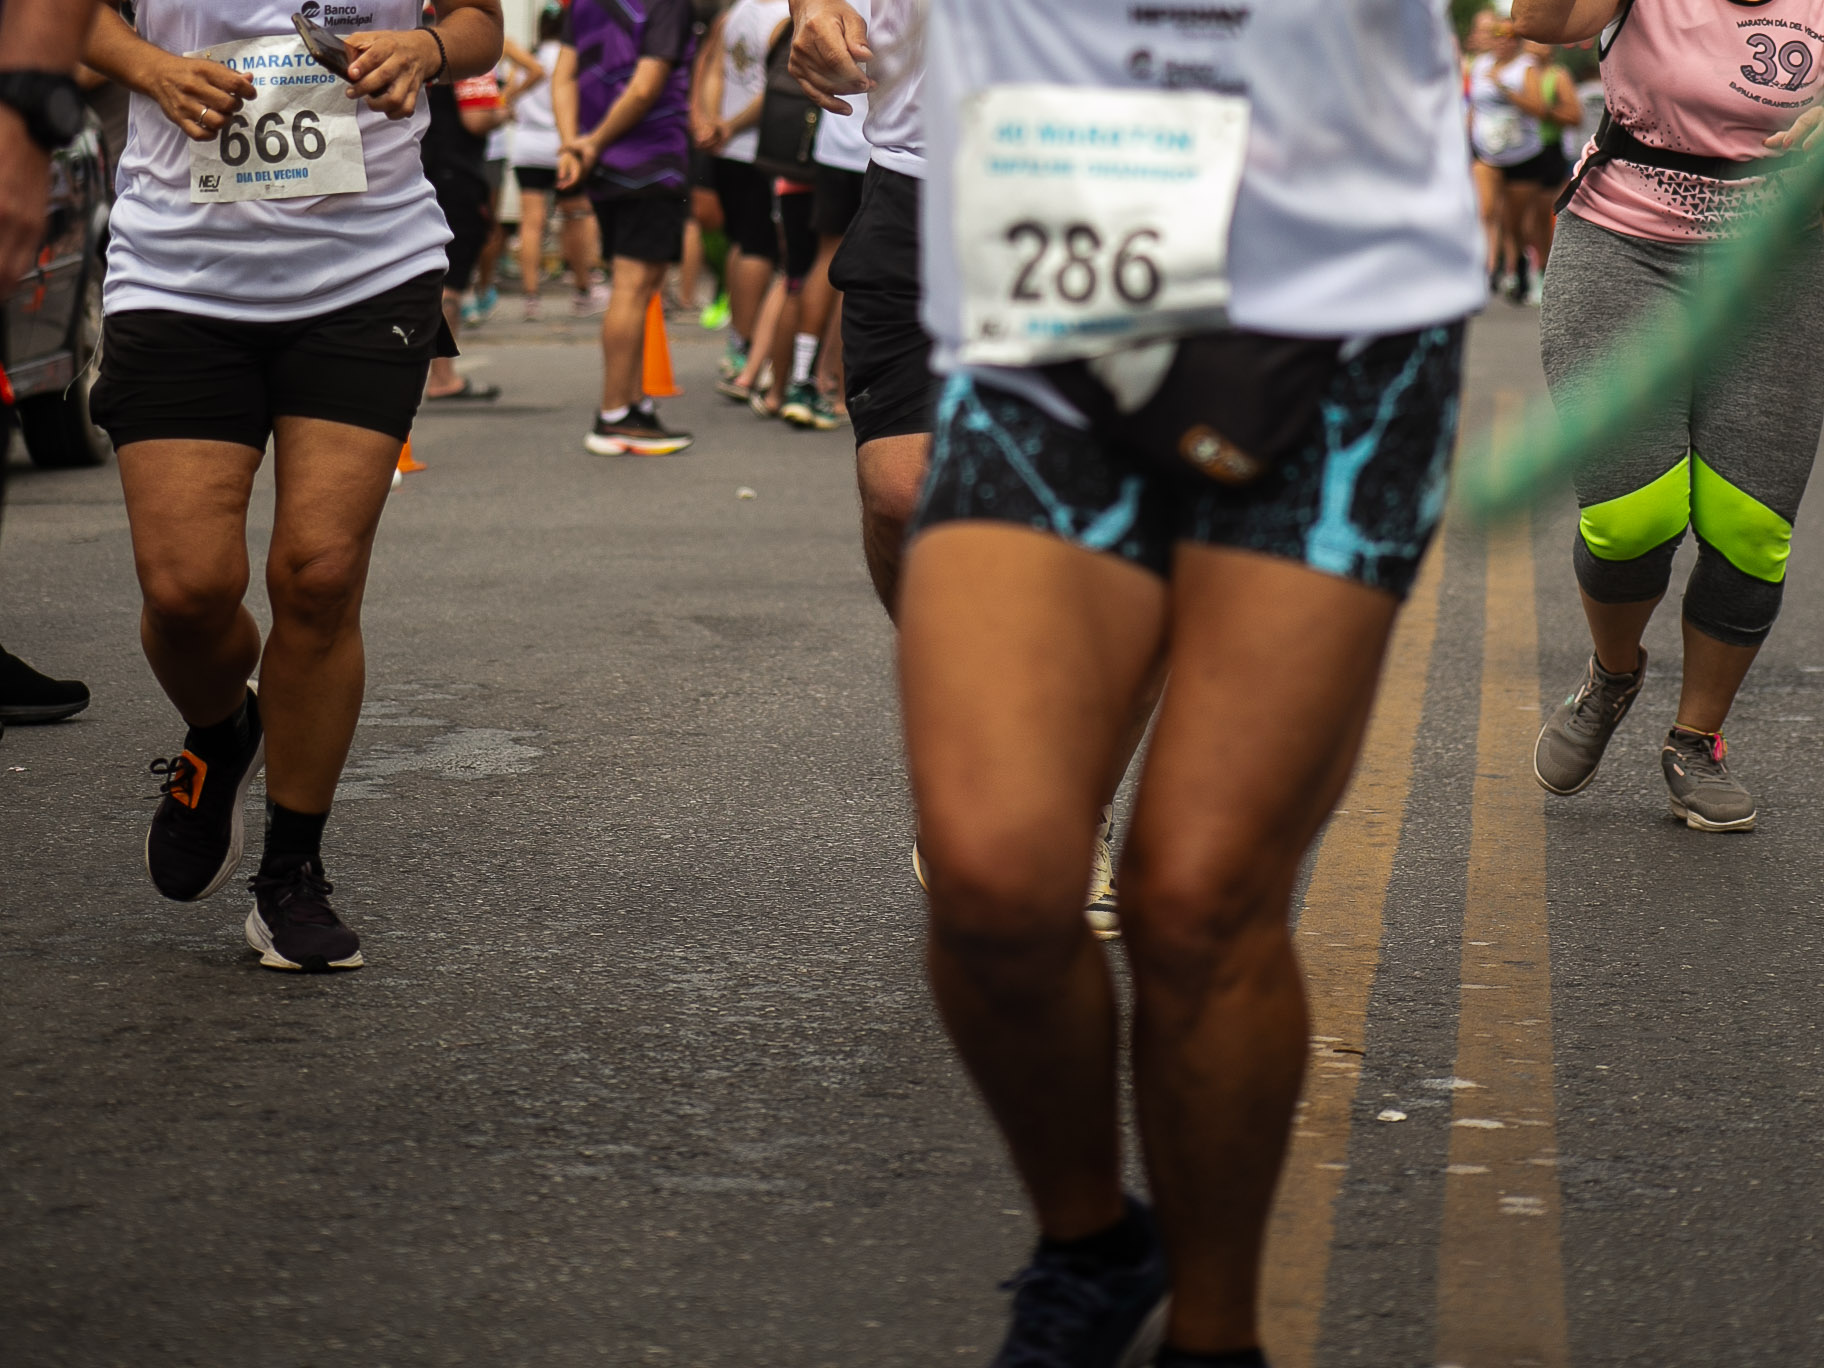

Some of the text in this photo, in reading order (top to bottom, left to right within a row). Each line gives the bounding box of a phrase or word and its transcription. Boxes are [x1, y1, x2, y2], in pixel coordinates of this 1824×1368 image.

[324, 5, 357, 15] Banco
[324, 13, 373, 27] Municipal
[1736, 18, 1774, 28] MARATÓN
[1775, 19, 1787, 28] DÍA
[1789, 22, 1803, 31] DEL
[243, 54, 317, 70] MARATO
[1740, 33, 1813, 92] 39
[270, 74, 336, 86] GRANEROS
[220, 110, 327, 167] 666
[198, 175, 221, 189] NEJ
[236, 167, 308, 184] DIA DEL VECINO
[1004, 218, 1162, 303] 286
